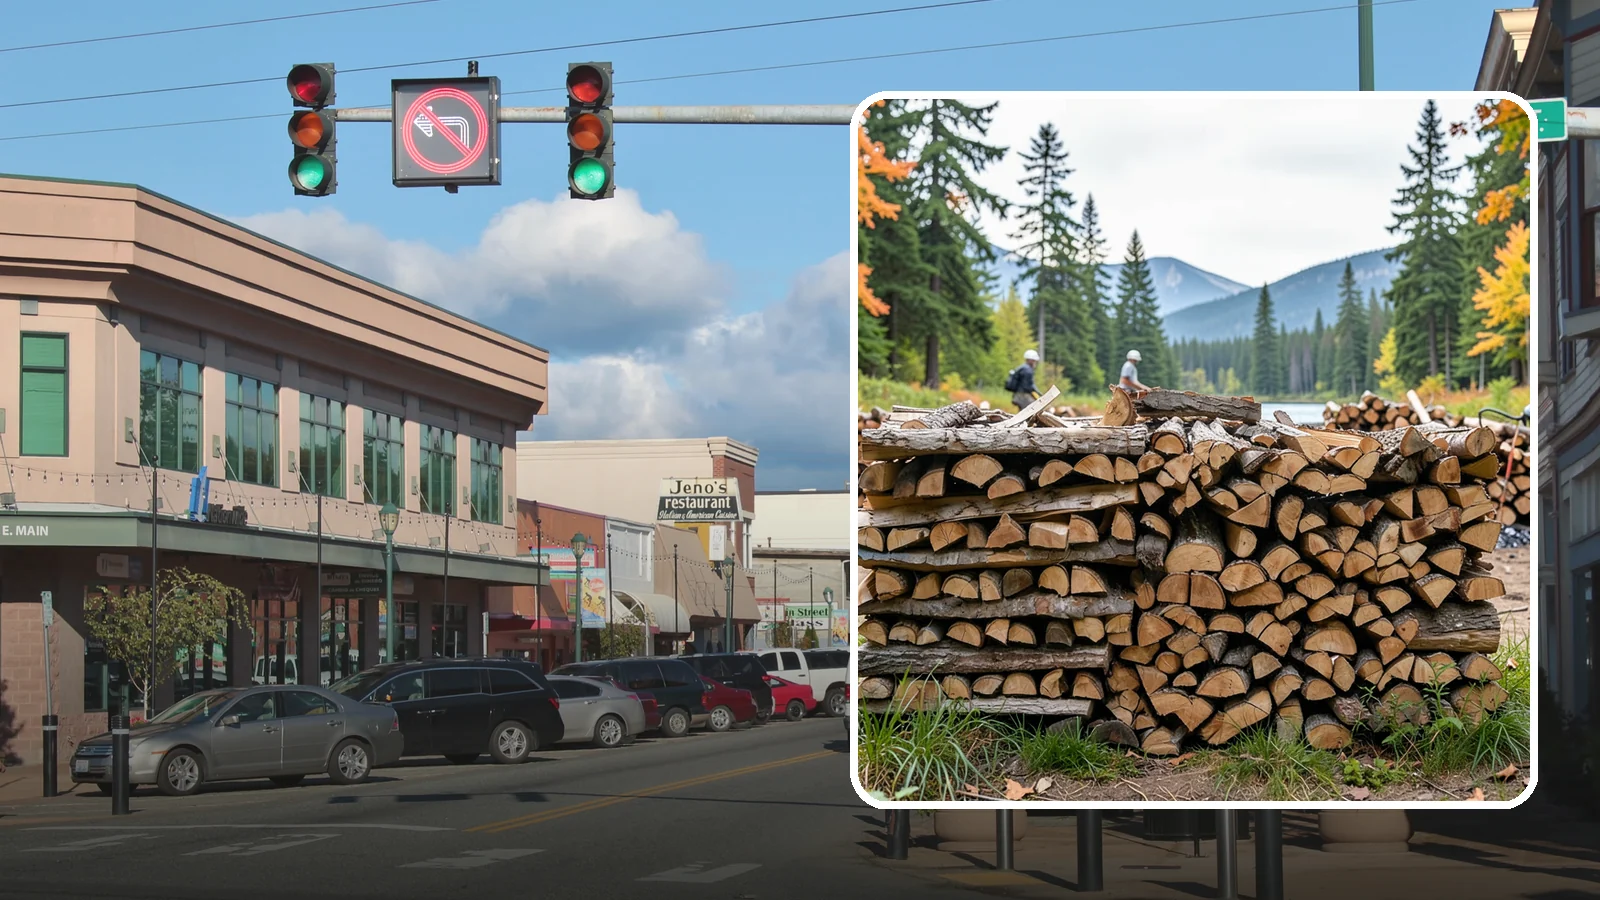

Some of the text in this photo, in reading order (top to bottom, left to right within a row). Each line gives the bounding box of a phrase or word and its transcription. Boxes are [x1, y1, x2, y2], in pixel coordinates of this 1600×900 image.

[670, 480, 727, 494] Jeno's
[665, 496, 731, 509] restaurant
[686, 510, 714, 519] American
[715, 510, 737, 519] Cuisine
[2, 525, 49, 537] E. MAIN
[786, 607, 828, 617] in Street
[790, 619, 823, 627] lass
